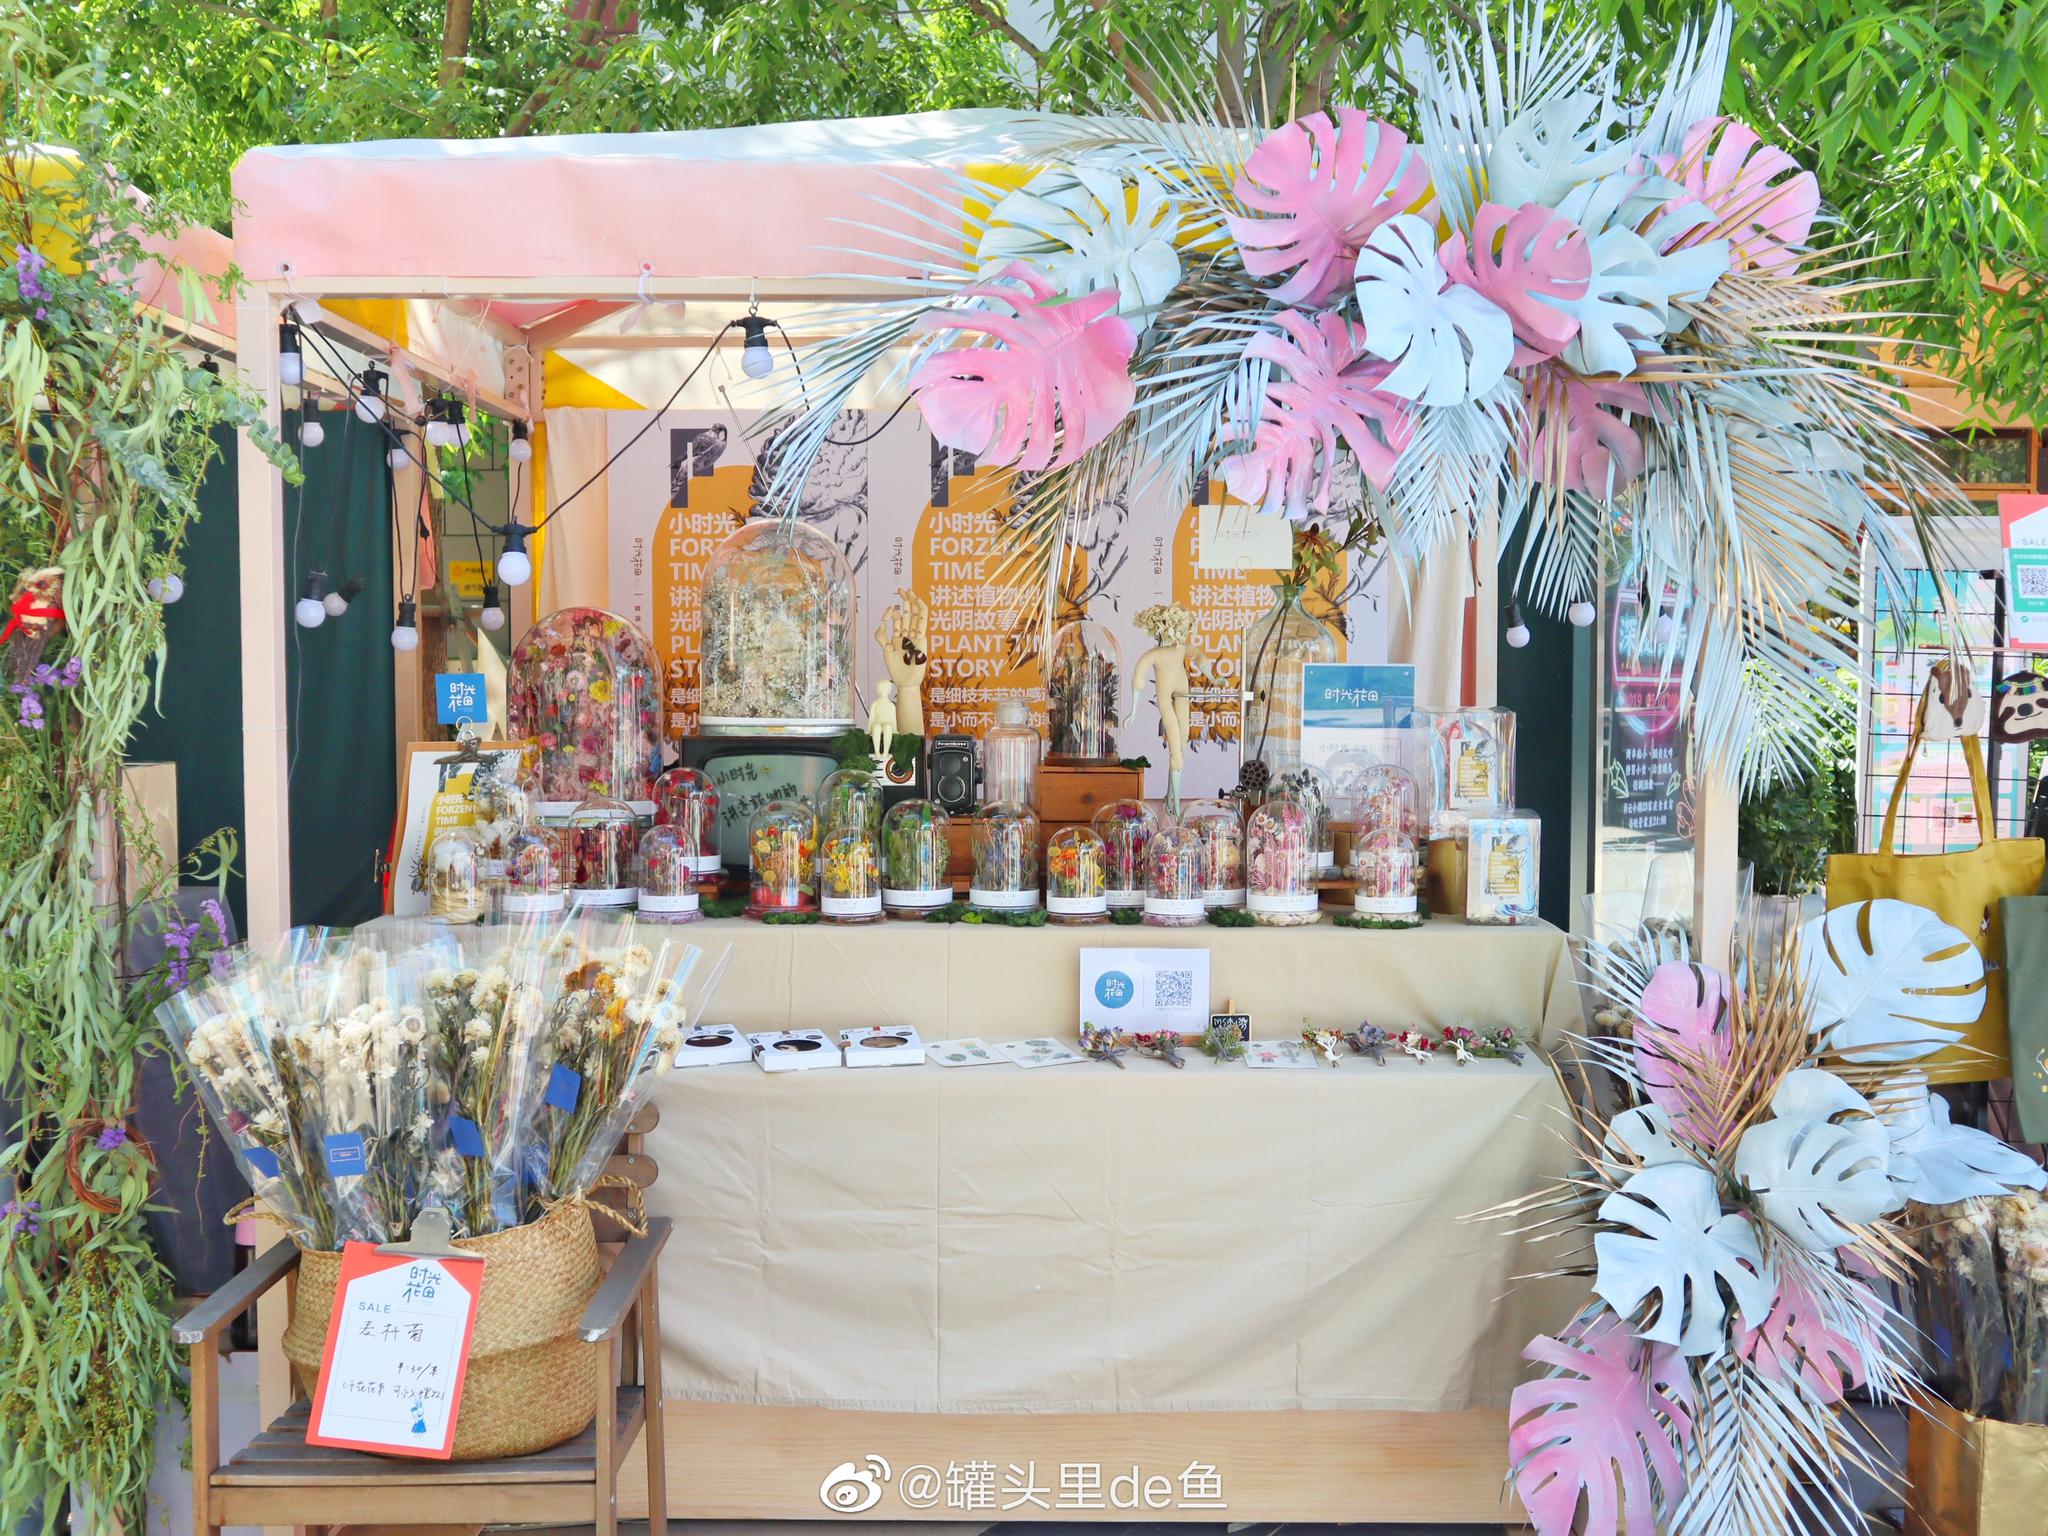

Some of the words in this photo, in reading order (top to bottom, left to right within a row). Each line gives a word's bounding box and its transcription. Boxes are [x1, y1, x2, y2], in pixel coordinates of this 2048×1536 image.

[668, 512, 736, 535] 小时光
[929, 511, 996, 534] 小时光
[2022, 538, 2047, 546] SALE
[928, 561, 986, 580] TIME
[930, 634, 1005, 653] PLANT
[930, 658, 1006, 678] STORY
[449, 682, 477, 696] 时光
[1324, 687, 1379, 708] 时光花田
[717, 762, 758, 786] 小时光
[436, 816, 459, 825] TIME
[409, 1266, 442, 1285] 时光
[402, 1281, 435, 1304] 花田
[358, 1301, 392, 1314] SALE
